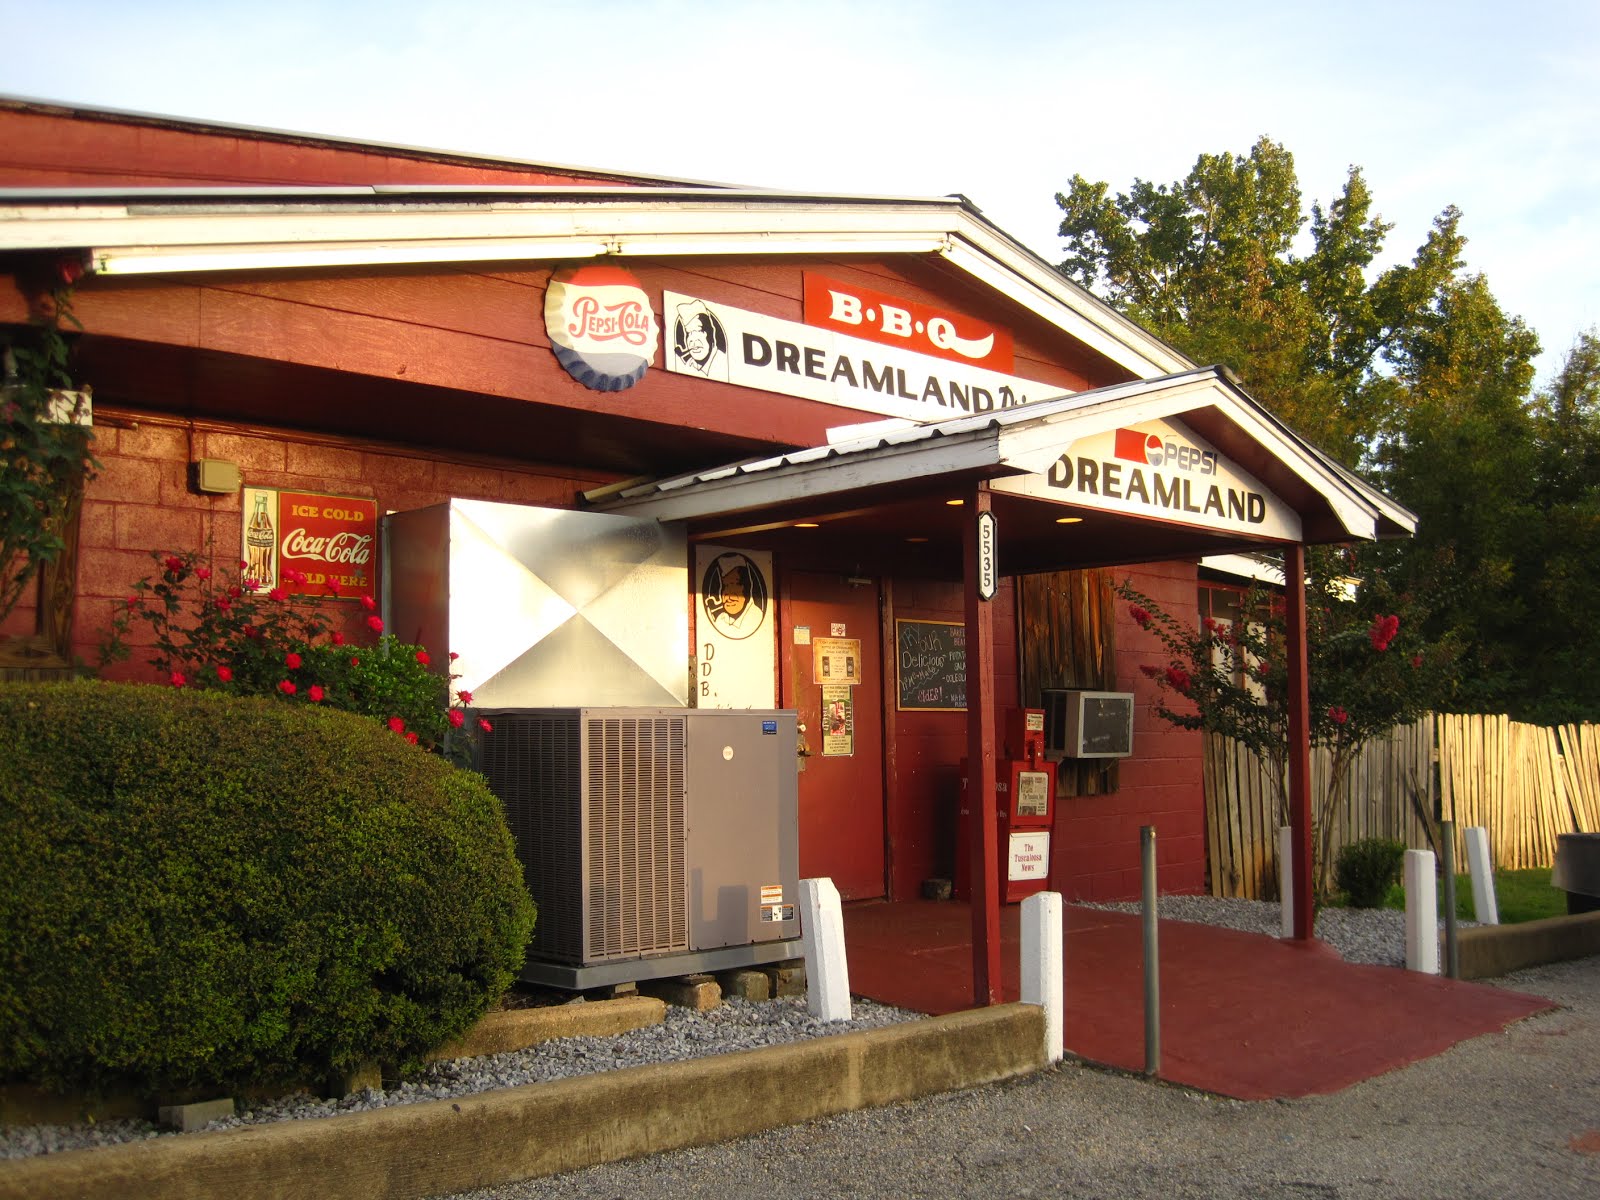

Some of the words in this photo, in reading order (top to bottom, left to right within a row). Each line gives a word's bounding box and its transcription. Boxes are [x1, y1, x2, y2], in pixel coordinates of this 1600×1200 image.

[742, 332, 994, 414] DREAMLAND
[1164, 442, 1218, 476] PEPSI
[1047, 453, 1266, 524] DREAMLAND
[292, 504, 319, 518] ICE
[323, 508, 364, 522] COLD
[982, 524, 992, 588] 5535
[1014, 853, 1042, 863] Tuscaloosa
[1024, 843, 1034, 852] The
[1021, 863, 1035, 872] News
